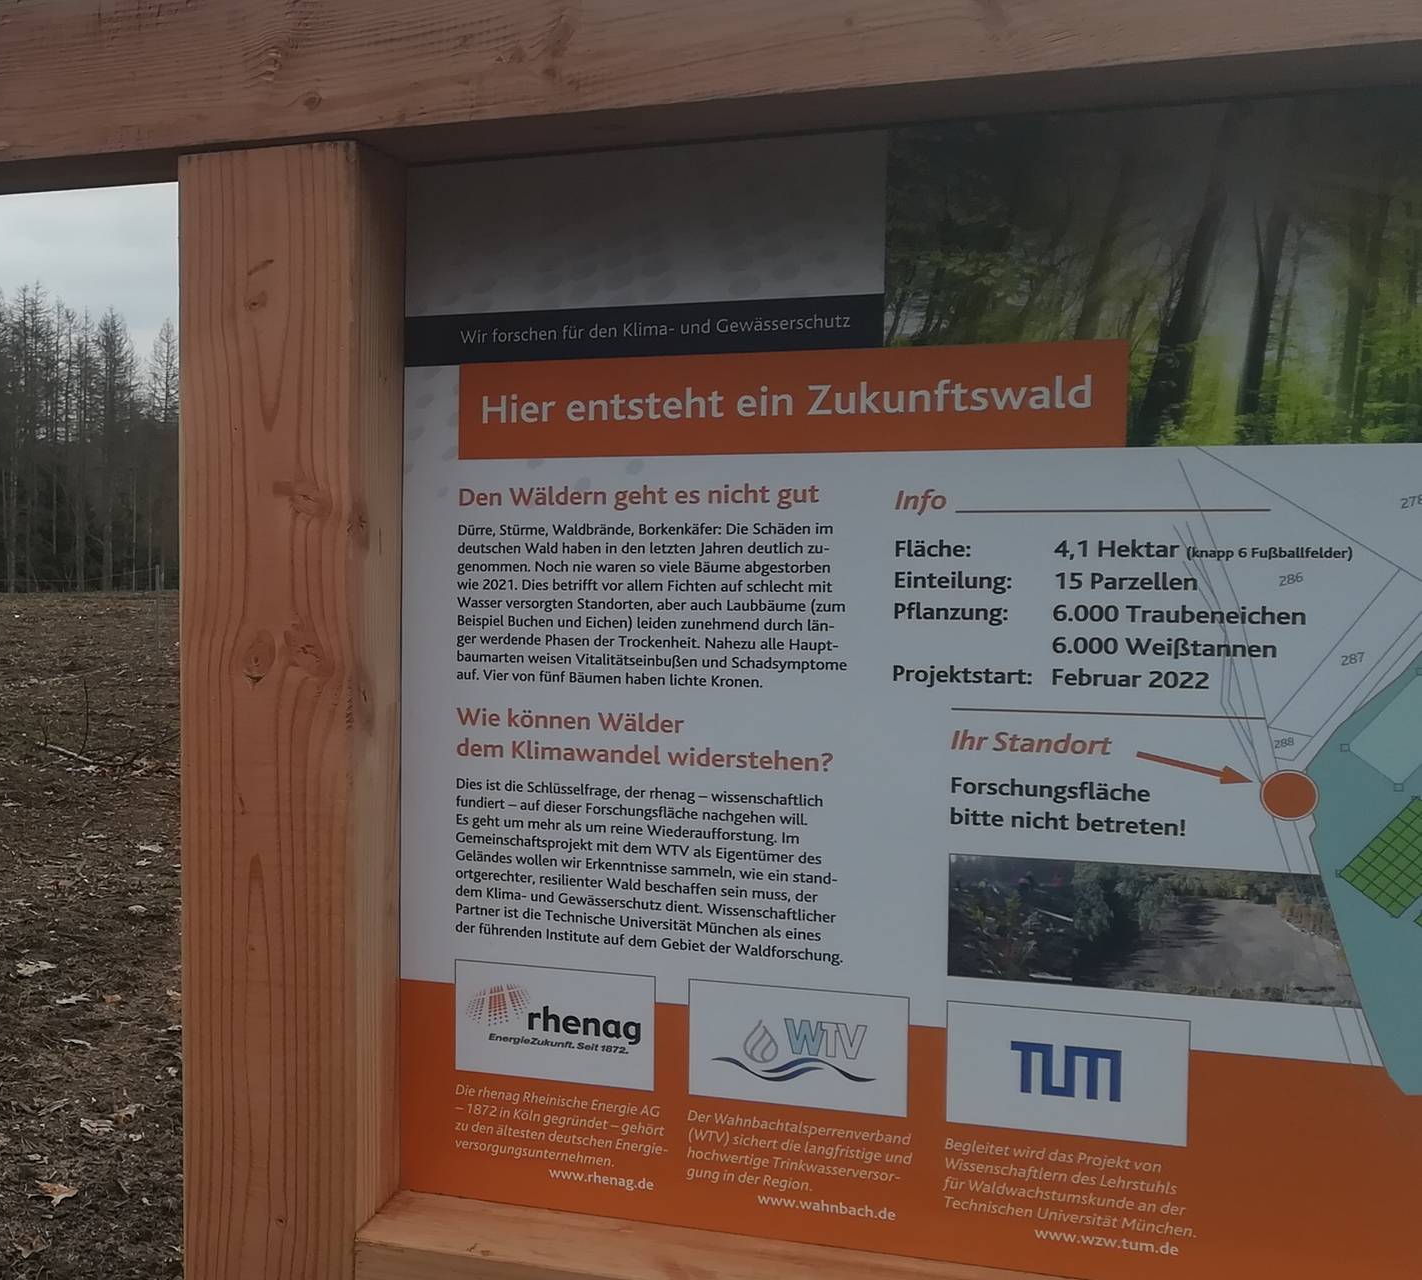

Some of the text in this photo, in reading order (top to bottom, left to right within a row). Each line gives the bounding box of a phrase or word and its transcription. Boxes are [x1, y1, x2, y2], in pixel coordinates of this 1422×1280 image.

[460, 314, 851, 344] Wir forschen für den Klima- und Gewässerschutz
[482, 374, 1092, 424] Hier entsteht ein Zukunftswald
[459, 483, 820, 511] Den Wäldern geht es nicht gut
[894, 488, 947, 516] Info
[458, 521, 833, 537] Dürre, Stürme, Waldbrände, Borkenkäfer: Die Schäden im
[895, 538, 1353, 563] Fläche: 4,1 Hektar (knapp 6 Fußballfelder)
[456, 560, 830, 577] genommen. Noch nie waren so viele Bäume abgestorben
[894, 570, 1198, 594] Einteilung: 15 Parzellen
[1278, 572, 1303, 586] 286
[456, 596, 845, 616] Wasser versorgten Standorten, aber auch Laubbäume (zum
[894, 601, 1306, 626] Pflanzung: 6.000 Traubeneichen
[456, 649, 847, 673] baumarten weisen Vitalitätseinbußen und Schadsymptome
[1052, 636, 1277, 660] 6.000 Weißtannen
[1341, 652, 1365, 666] 287
[456, 668, 763, 688] auf. Vier von fünf Bäumen haben lichte Kronen.
[893, 664, 1209, 689] Projektstart: Februar 2022
[456, 707, 685, 733] Wie können Wälder
[456, 737, 833, 772] dem Klimawandel widerstehen?
[950, 729, 1113, 756] Ihr Standort
[1274, 737, 1295, 749] 288
[951, 776, 1150, 804] Forschungsfläche
[950, 807, 1185, 837] bitte nicht betreten!
[455, 831, 822, 865] Gemeinschaftsprojekt mit dem WTV als Eigentümer des
[455, 884, 837, 923] dem Klima- und Gewässerschutz dient. Wissenschaftlicher
[455, 902, 821, 941] Partner ist die Technische Universität München als eines
[455, 920, 843, 966] der führenden Institute auf dem Gebiet der Waldforschung.
[528, 1006, 641, 1045] rhenag
[784, 1018, 868, 1060] WTV
[577, 1042, 599, 1052] Seit
[600, 1045, 629, 1055] 1872.
[1010, 1040, 1122, 1102] TUM
[455, 1083, 660, 1117] Die rhenag Rheinische Energie AG
[687, 1109, 911, 1145] Der Wahnbachtalsperrenverband
[455, 1139, 614, 1167] versorgungsunternehmen.
[686, 1146, 901, 1182] hochwertige Trinkwasserversor-
[944, 1137, 1162, 1173] Begleitet wird das Projekt von
[548, 1168, 654, 1191] www.rhenag.de
[685, 1168, 812, 1192] gung in der Region.
[945, 1156, 1177, 1195] Wissenschaftlern des Lehrstuhls
[757, 1194, 896, 1221] www.wahnbach.de
[942, 1176, 1186, 1216] für Waldwachstumskunde an der
[944, 1195, 1197, 1238] Technischen Universität München.
[1034, 1229, 1179, 1256] www.wzw.tum.de
